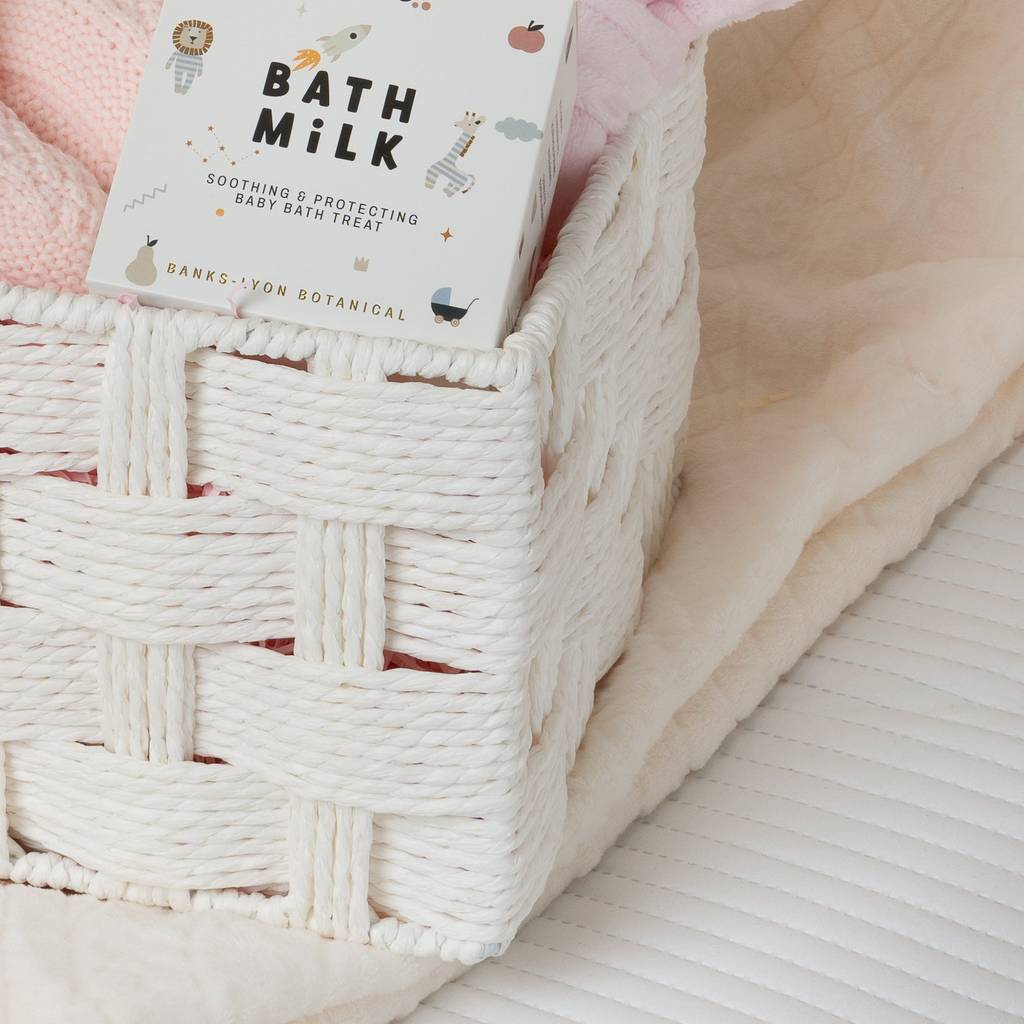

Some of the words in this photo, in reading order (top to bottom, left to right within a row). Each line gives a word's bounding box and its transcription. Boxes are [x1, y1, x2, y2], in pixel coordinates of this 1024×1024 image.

[262, 61, 417, 123] BATH
[206, 173, 290, 199] SOOTHING
[297, 191, 306, 202] &
[313, 194, 418, 226] PROTECTING
[235, 193, 277, 211] BABY
[283, 203, 324, 221] BATH
[333, 212, 383, 232] TREAT
[298, 289, 406, 321] BOTANICAL
